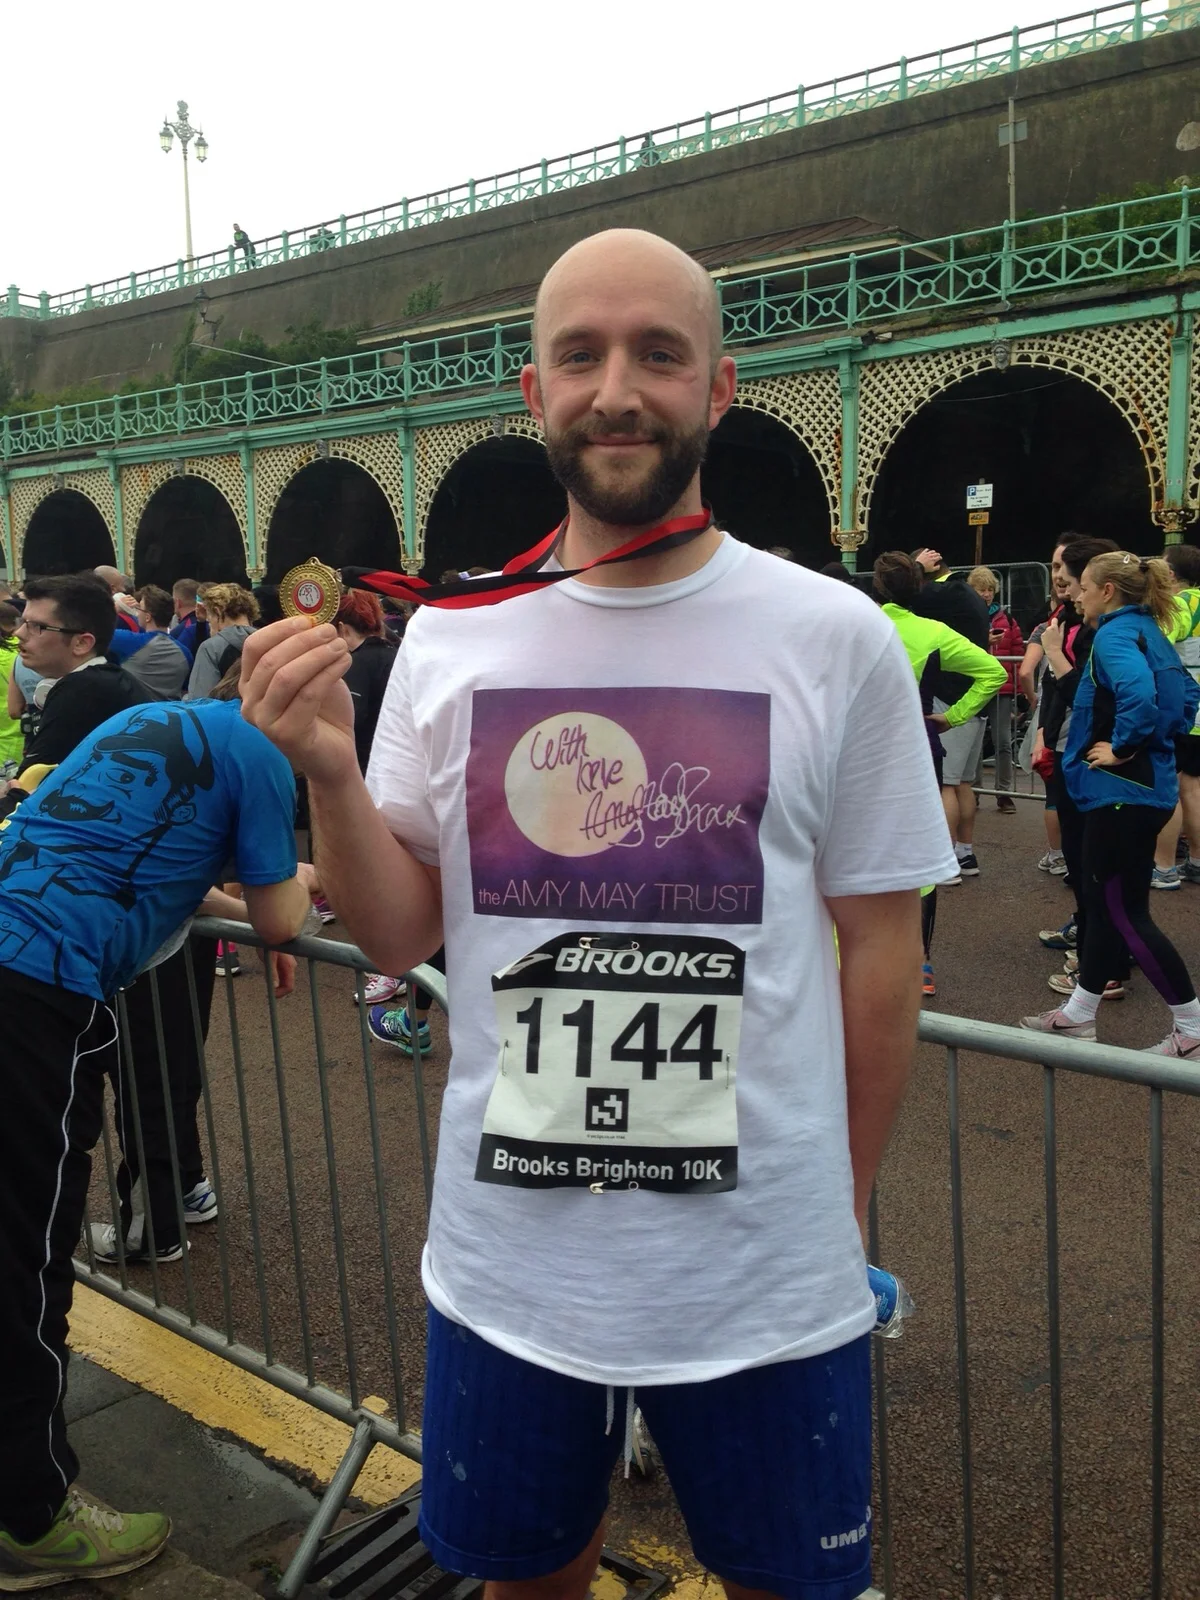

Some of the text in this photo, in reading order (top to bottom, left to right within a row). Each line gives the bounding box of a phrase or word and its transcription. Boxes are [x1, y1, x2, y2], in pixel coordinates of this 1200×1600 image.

[530, 724, 590, 770] With
[577, 755, 624, 795] love
[478, 879, 757, 913] the AMY MAY TRUST
[555, 947, 735, 979] BROOKS
[516, 996, 723, 1081] 1144
[492, 1148, 722, 1183] Brooks Brighton 10K
